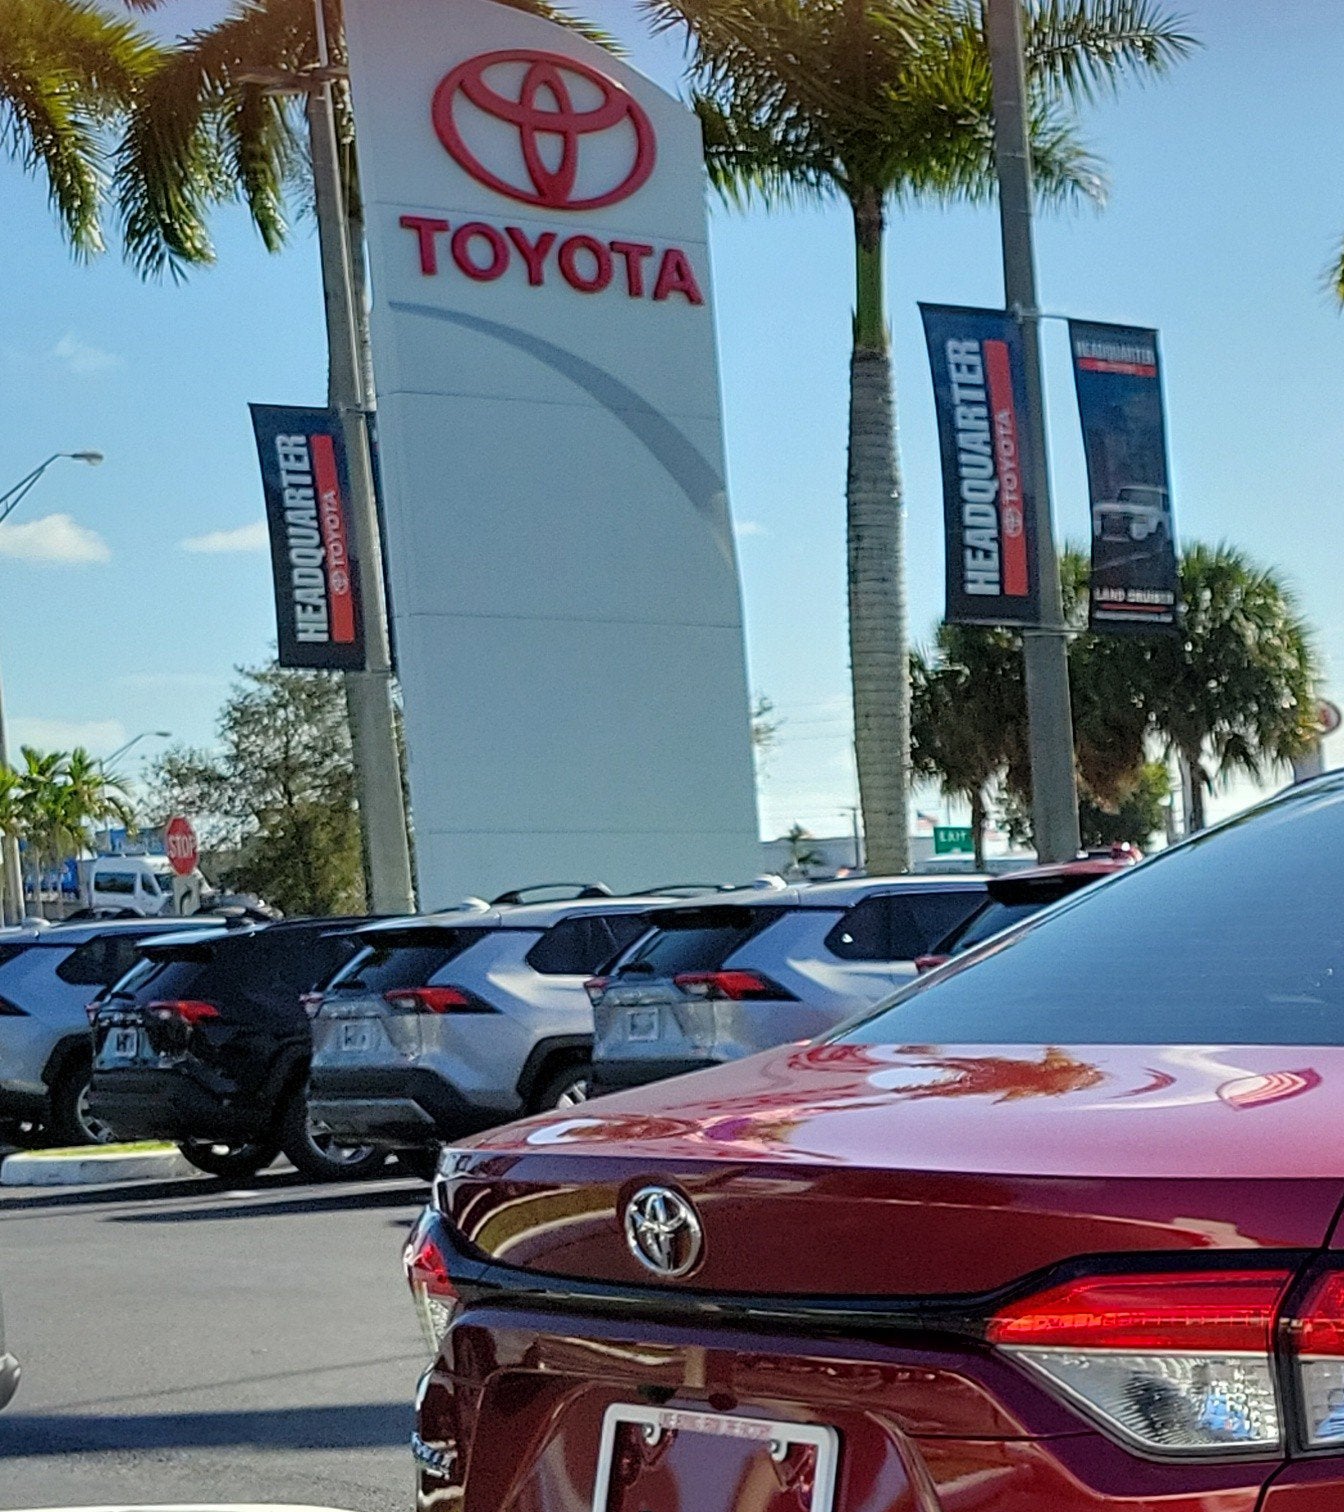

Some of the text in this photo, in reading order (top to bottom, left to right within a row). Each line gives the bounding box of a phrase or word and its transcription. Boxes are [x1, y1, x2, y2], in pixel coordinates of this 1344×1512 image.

[399, 216, 704, 306] TOYOTA
[946, 338, 1001, 597] HEADQUARTER
[995, 410, 1019, 501] TOYOTA
[275, 434, 330, 643] HEADQUARTER
[323, 490, 347, 567] TOYOTA
[1093, 587, 1126, 602] LAND
[168, 834, 197, 858] STOP
